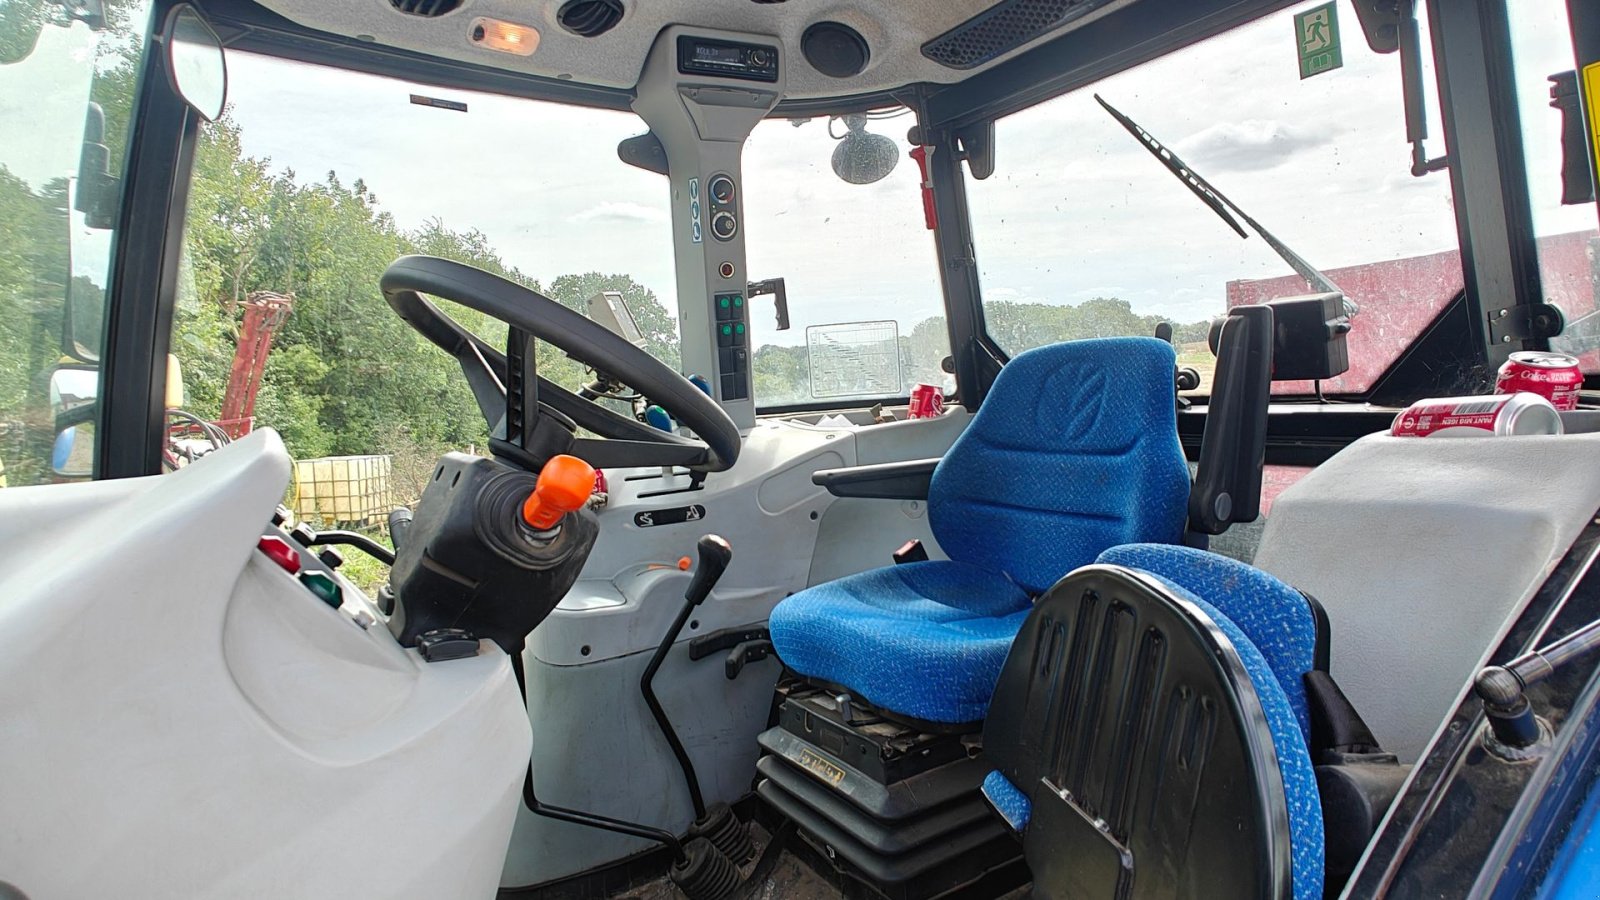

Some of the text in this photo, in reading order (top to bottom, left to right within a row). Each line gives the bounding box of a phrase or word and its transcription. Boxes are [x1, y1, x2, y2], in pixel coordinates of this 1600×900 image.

[1520, 370, 1547, 381] Coke
[1459, 417, 1473, 425] MIG
[1474, 416, 1493, 424] PANT
